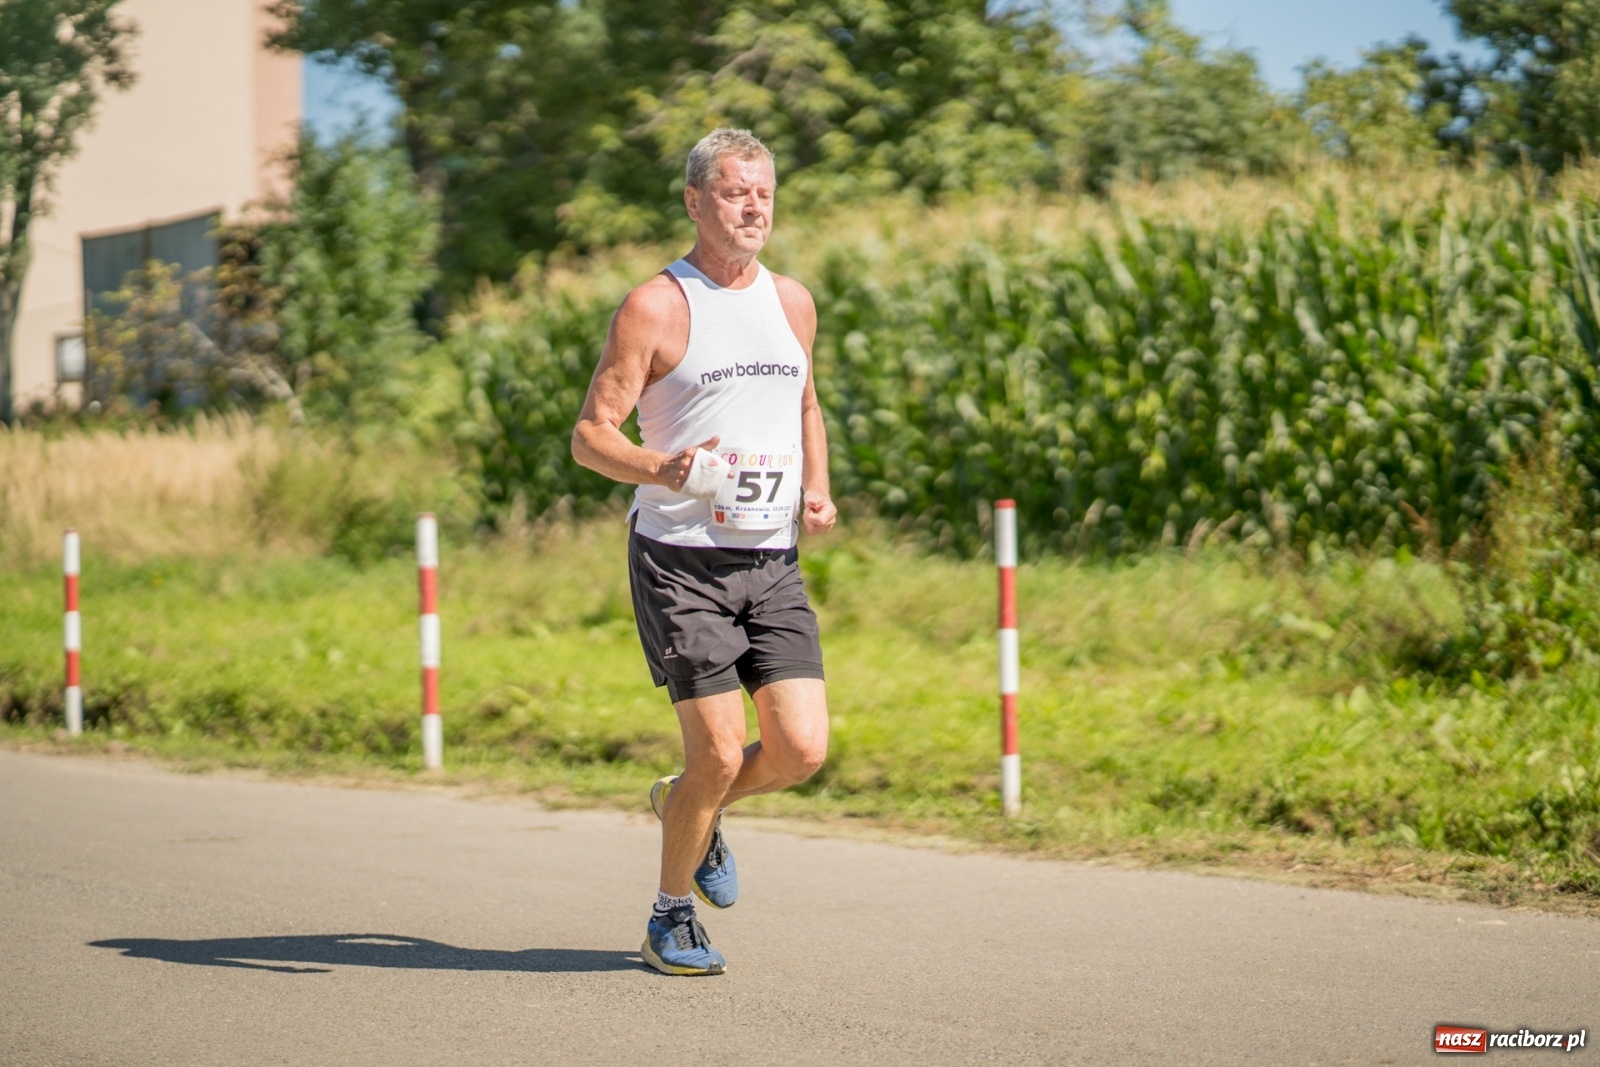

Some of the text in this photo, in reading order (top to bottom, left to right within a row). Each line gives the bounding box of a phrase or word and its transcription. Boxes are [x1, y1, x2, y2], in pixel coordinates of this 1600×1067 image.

[700, 361, 799, 385] new balance
[777, 454, 793, 468] RUN
[735, 471, 784, 503] 57
